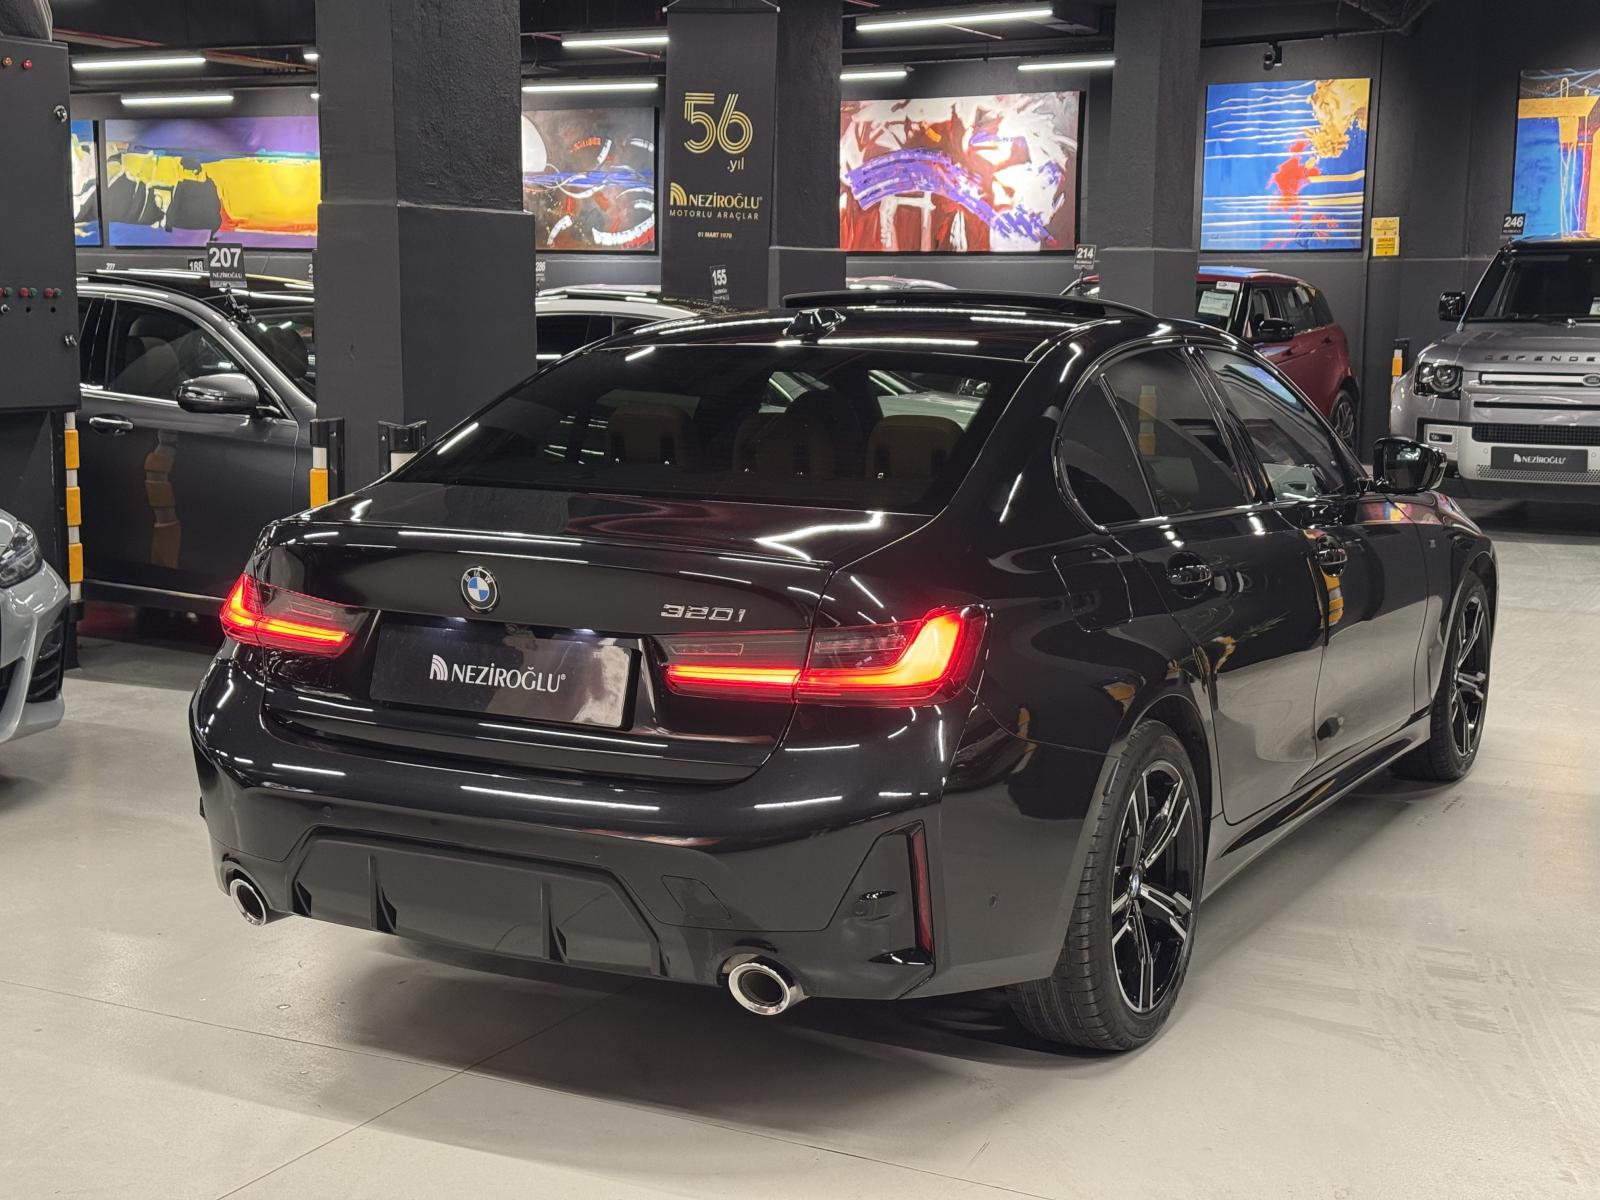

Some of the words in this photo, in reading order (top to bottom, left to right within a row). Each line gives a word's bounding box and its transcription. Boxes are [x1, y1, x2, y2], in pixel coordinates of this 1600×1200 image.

[684, 92, 753, 154] 56
[669, 209, 712, 218] MOTORLU
[717, 211, 759, 221] ARAÇLAR
[1503, 216, 1524, 228] 246
[209, 247, 242, 268] 207
[1076, 247, 1094, 259] 214
[712, 269, 727, 286] 155
[463, 569, 494, 584] BMW
[660, 604, 746, 623] 320i
